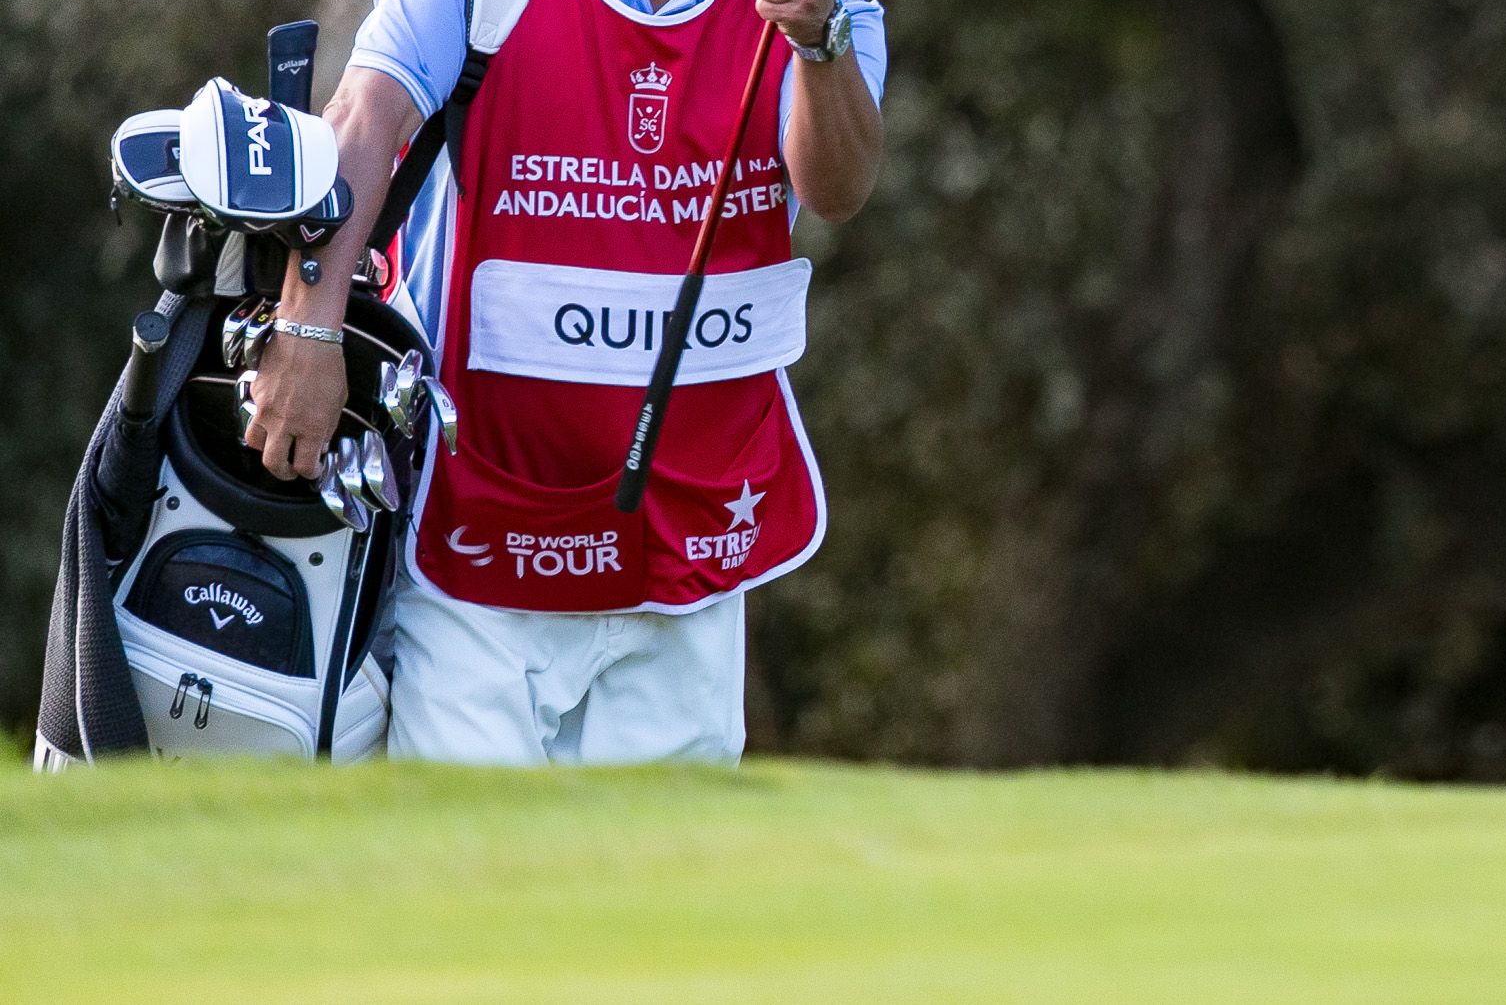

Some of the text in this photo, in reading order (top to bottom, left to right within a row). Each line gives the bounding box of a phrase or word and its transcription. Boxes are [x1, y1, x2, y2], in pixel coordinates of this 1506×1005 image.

[511, 154, 647, 189] ESTRELLA
[493, 189, 667, 225] ANDALUCÍA
[506, 530, 619, 549] DP WORLD
[507, 545, 623, 579] TOUR
[184, 581, 264, 626] Callaway
